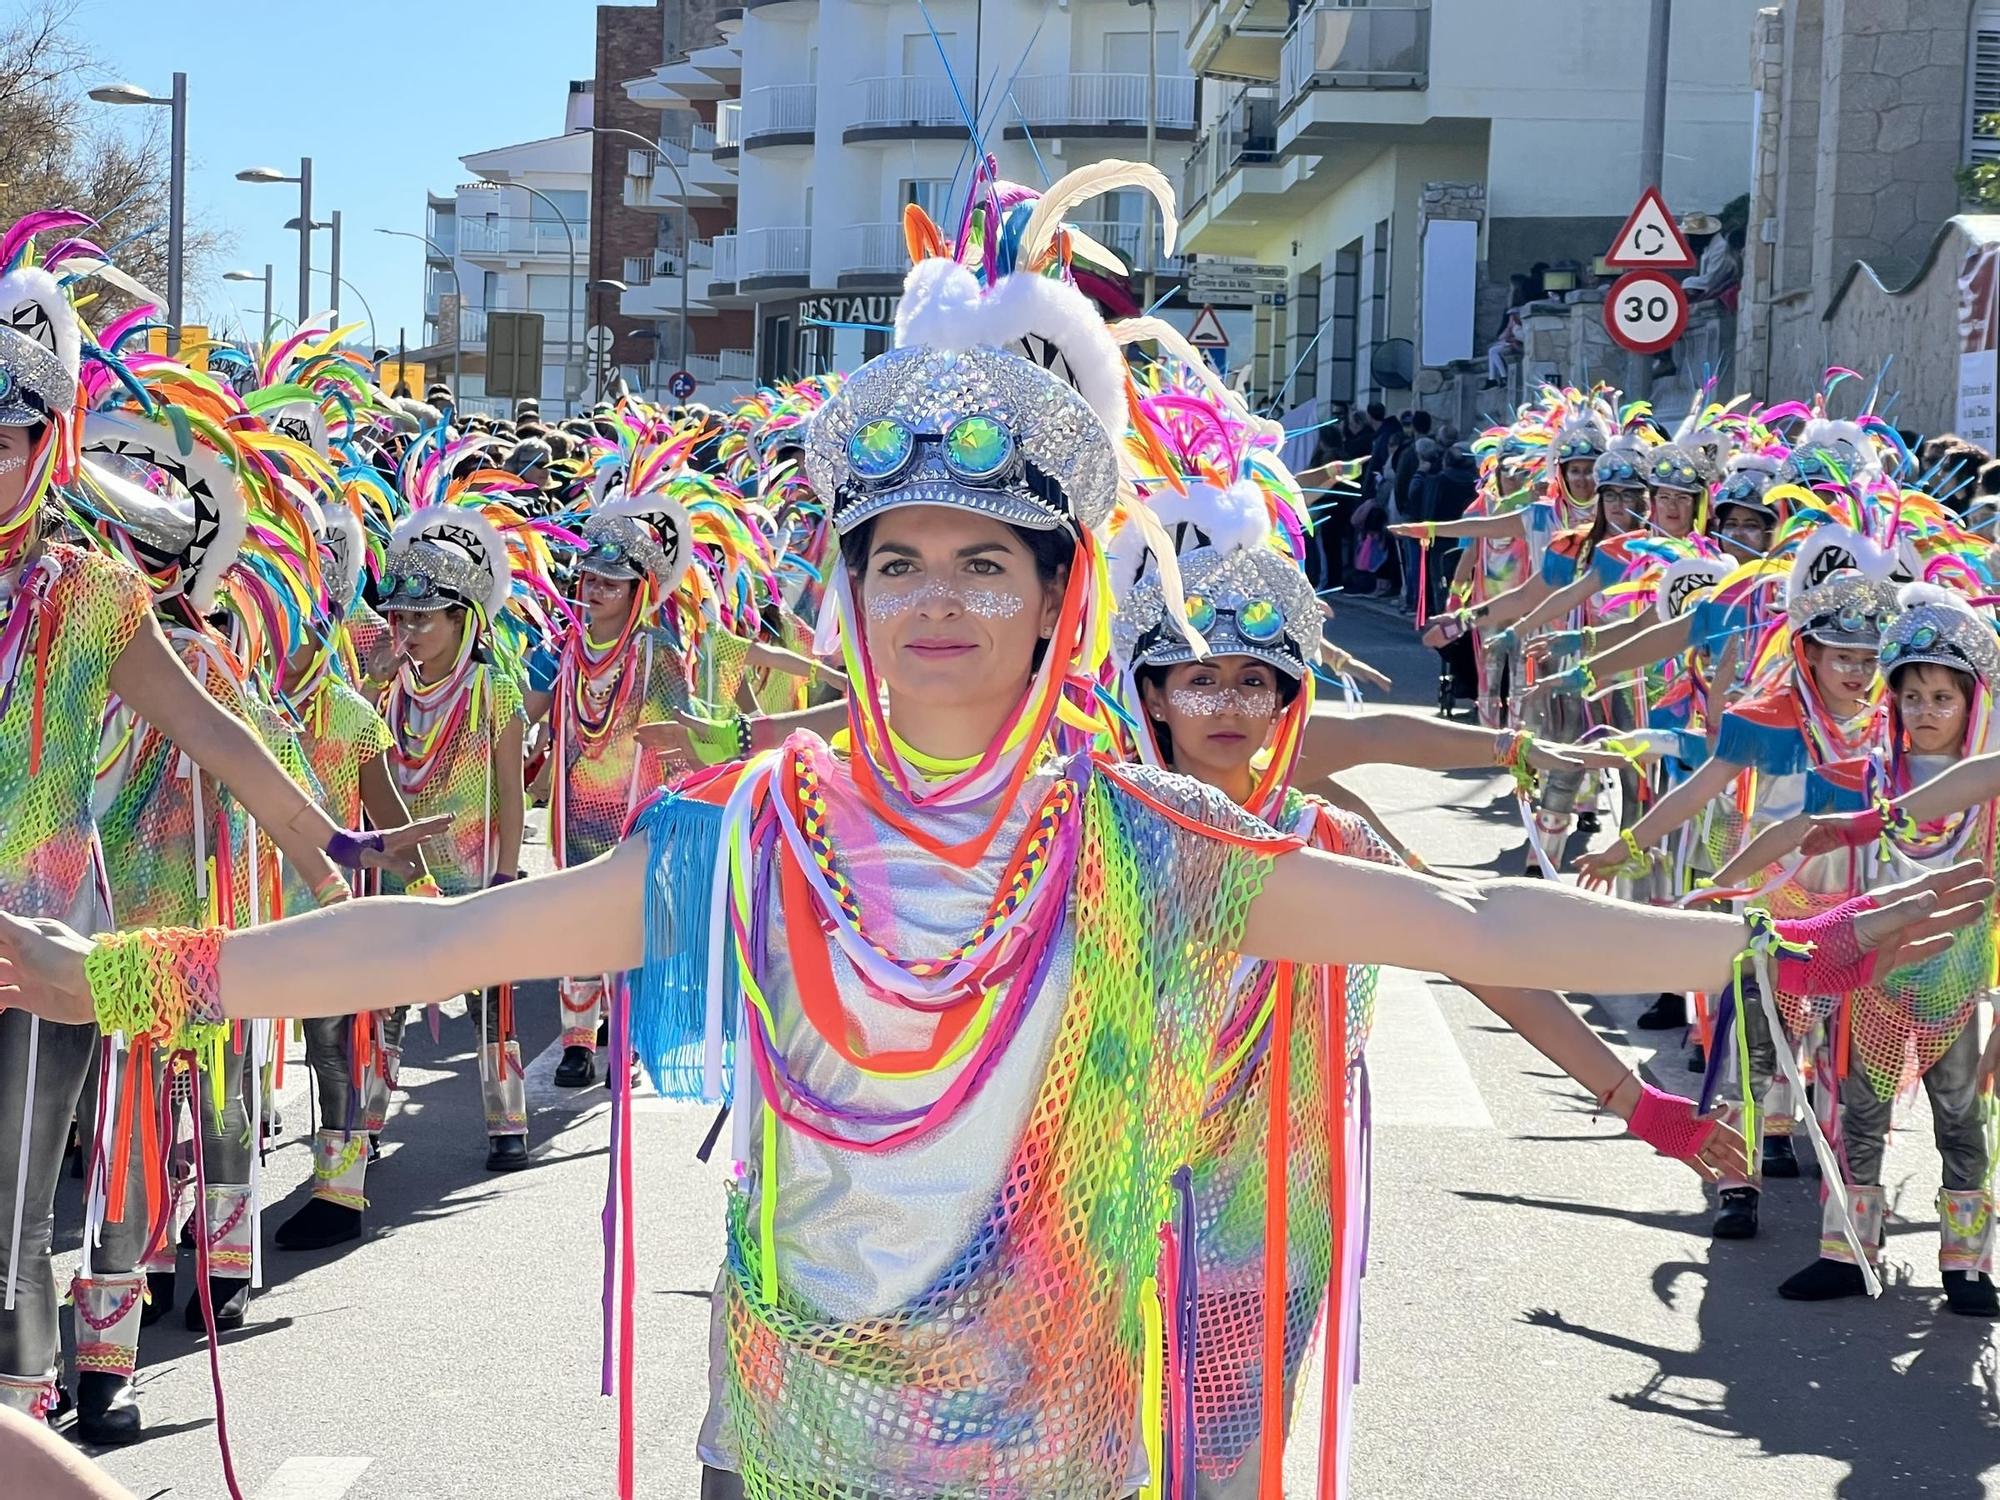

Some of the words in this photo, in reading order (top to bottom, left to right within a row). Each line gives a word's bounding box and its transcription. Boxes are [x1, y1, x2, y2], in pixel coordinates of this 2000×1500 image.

[1192, 279, 1216, 287] Centre
[1218, 280, 1228, 288] de
[1229, 280, 1237, 288] la
[1624, 296, 1668, 322] 30
